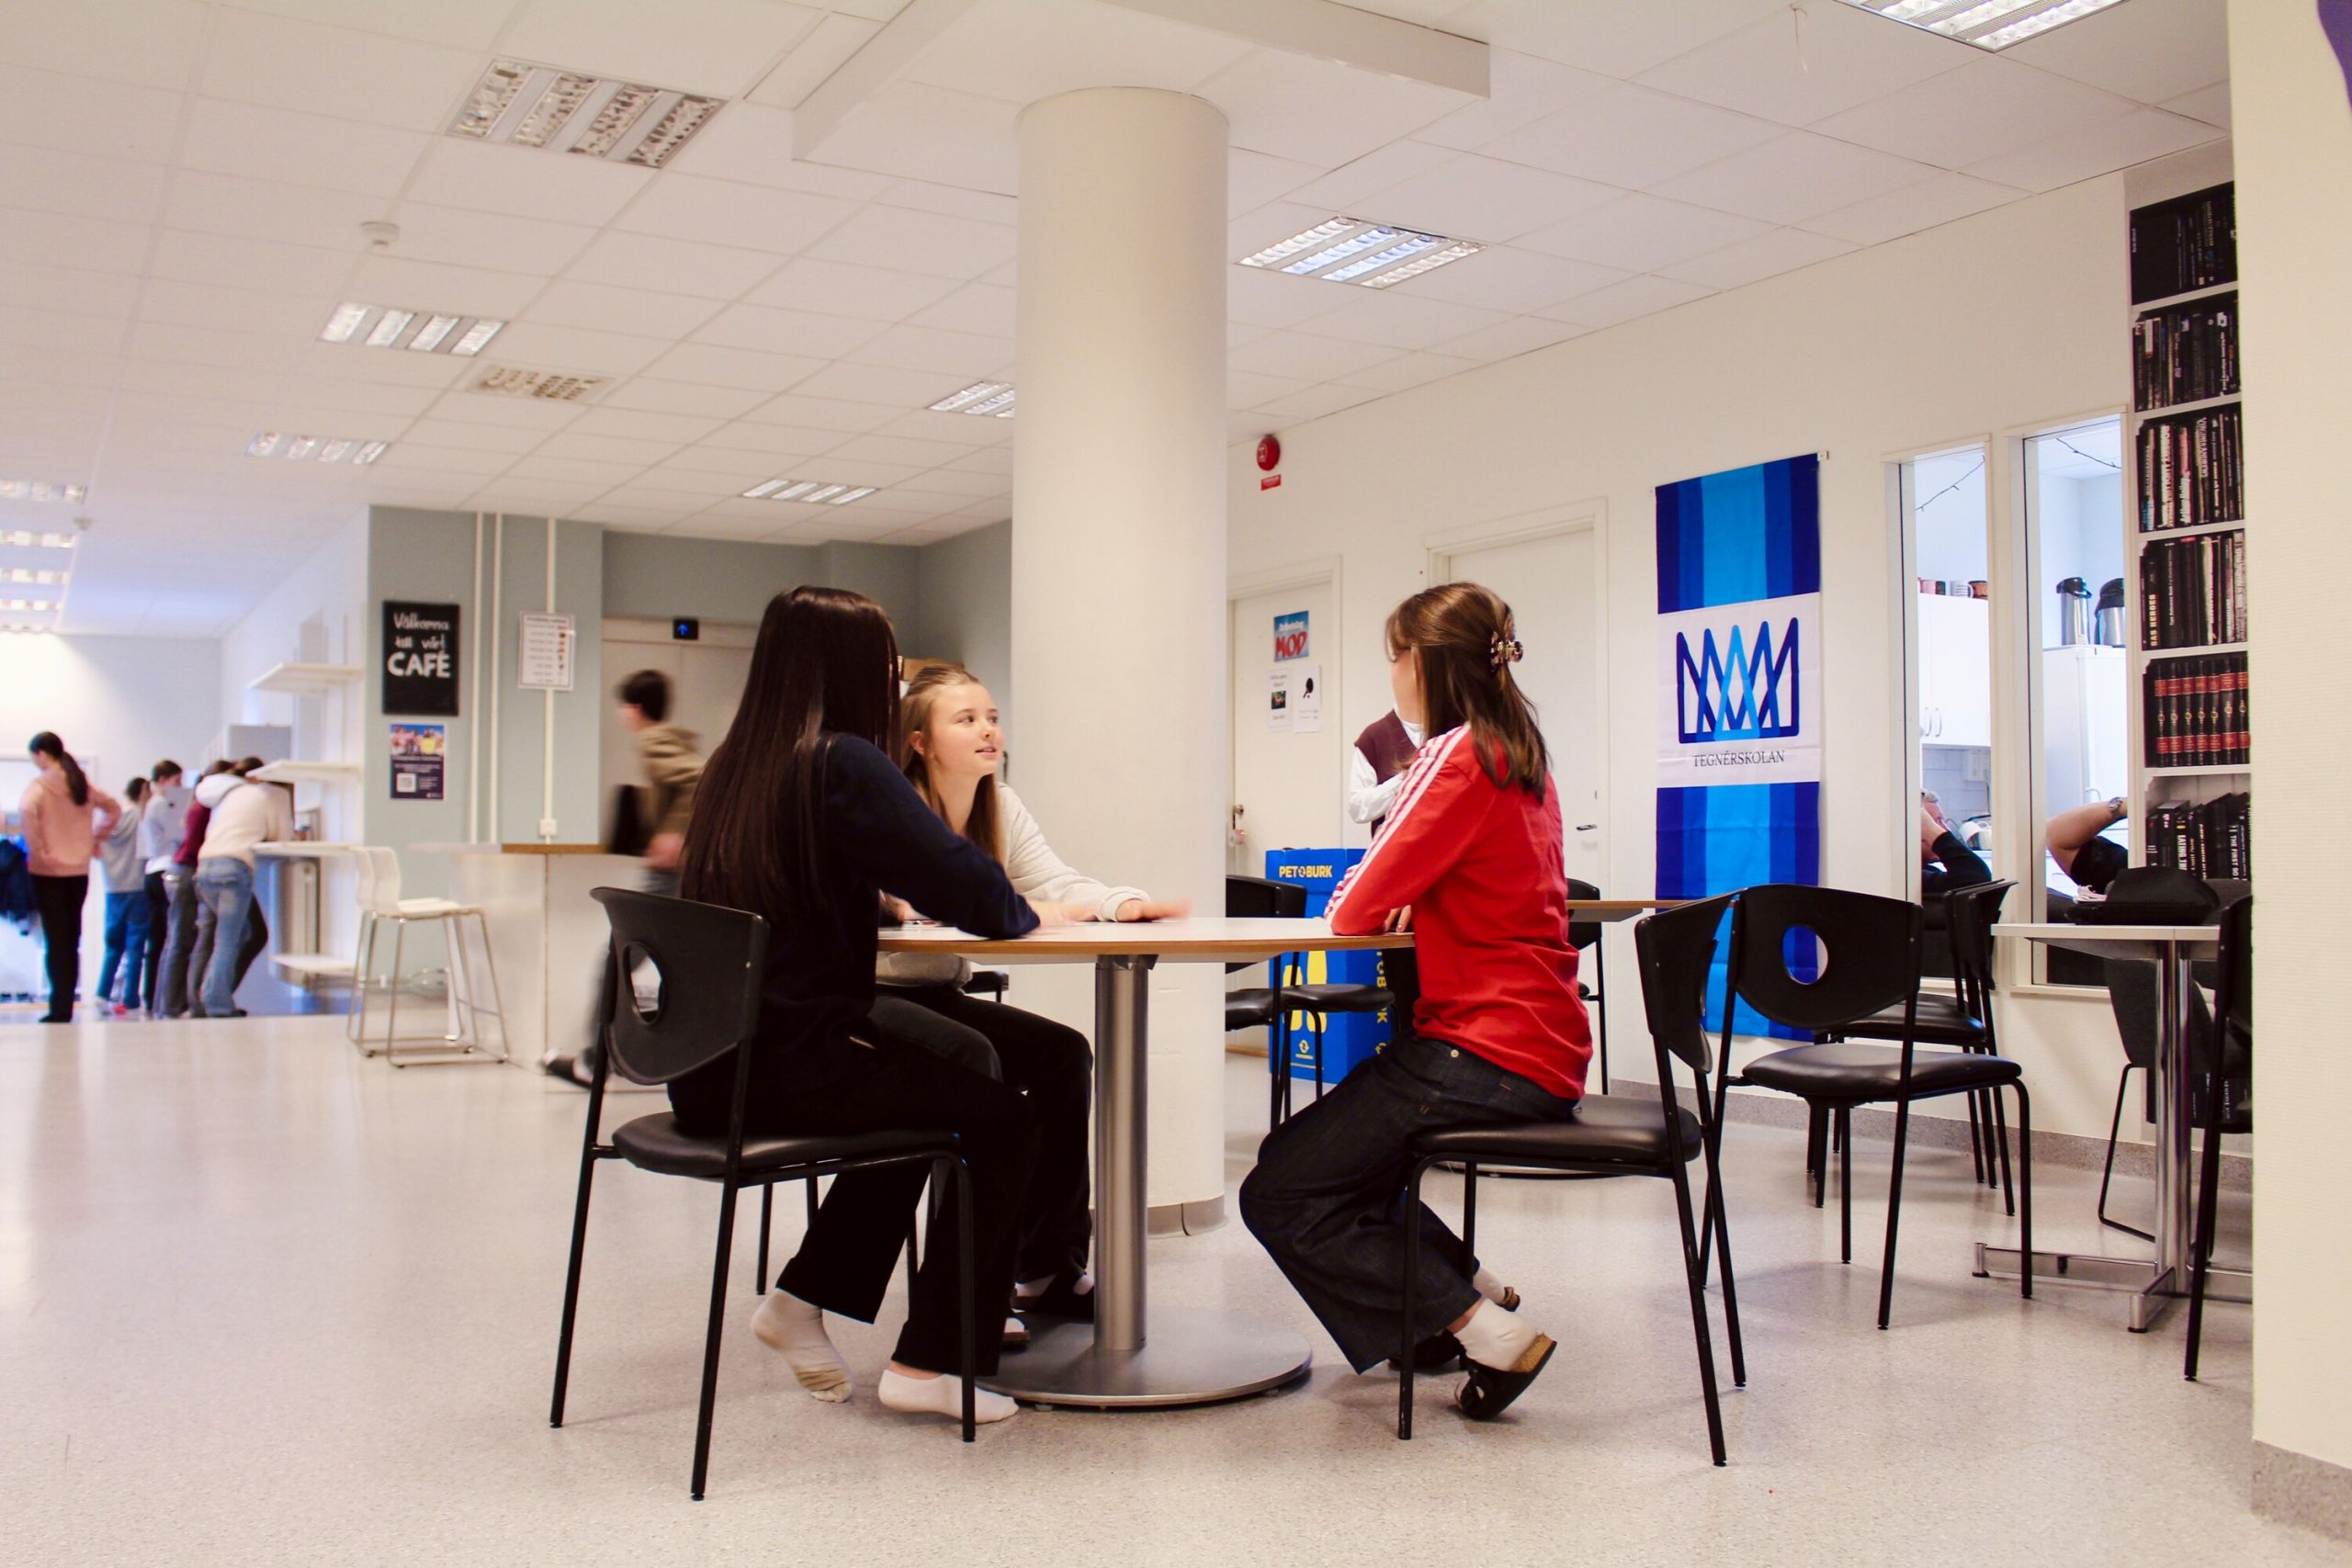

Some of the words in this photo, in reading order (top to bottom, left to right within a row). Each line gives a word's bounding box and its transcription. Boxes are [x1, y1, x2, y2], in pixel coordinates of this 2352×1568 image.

[2148, 593, 2157, 627] HEROES
[393, 612, 449, 630] Välkomna
[395, 636, 413, 649] till
[2149, 629, 2158, 647] SAS
[387, 649, 450, 678] CAFÉ
[1693, 750, 1785, 767] TEGNÉRSKOLAN
[1279, 865, 1298, 878] PET
[1306, 864, 1332, 878] BURK
